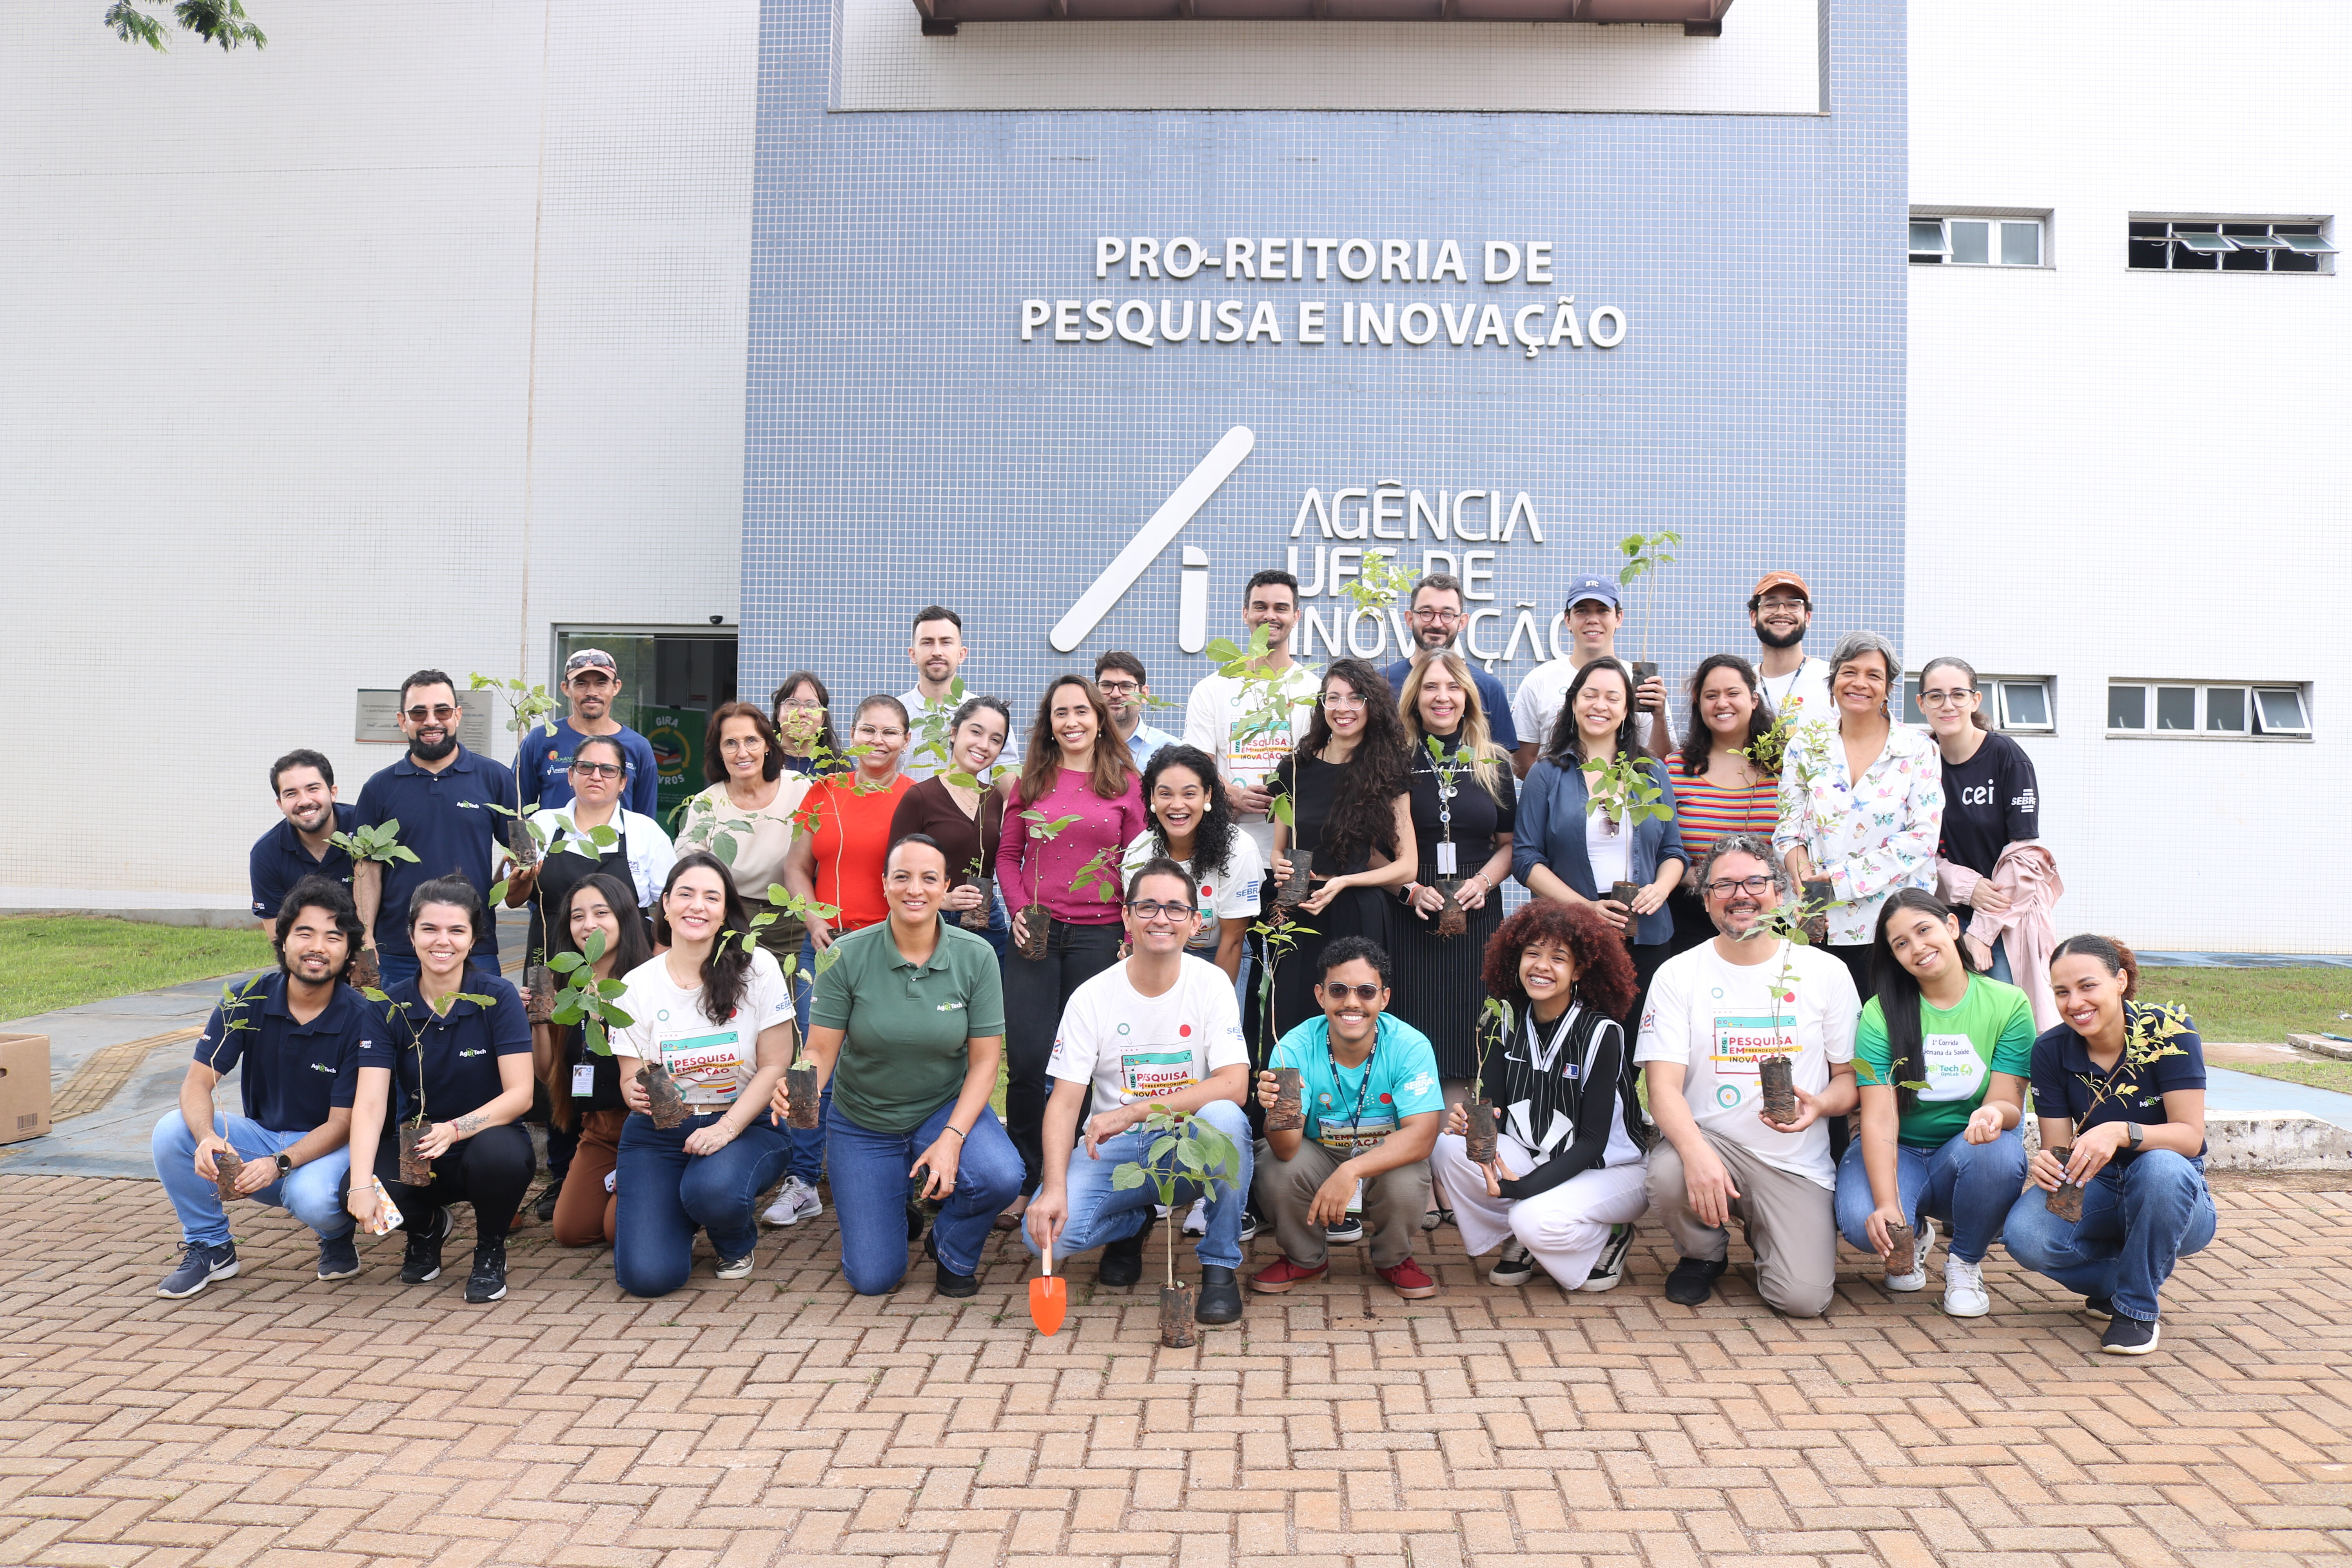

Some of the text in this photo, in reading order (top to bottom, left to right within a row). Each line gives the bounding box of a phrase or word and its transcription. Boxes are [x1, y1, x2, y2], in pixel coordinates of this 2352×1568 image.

[1484, 240, 1553, 283] DE
[1021, 295, 1627, 358] PESQUISA E INOVAÇÃO
[1290, 479, 1544, 543] AGÊNCIA
[656, 716, 679, 728] GIRA
[658, 774, 685, 785] VROS
[1962, 779, 1994, 805] cei
[456, 800, 479, 809] AgBiTech
[1236, 887, 1260, 898] SEBR
[937, 1002, 963, 1011] AgBiTech
[1054, 1036, 1064, 1054] ei
[1729, 1036, 1793, 1047] PESQUISA
[459, 1048, 486, 1058] AgBiTech
[674, 1053, 735, 1067] PESQUISA
[311, 1063, 337, 1074] AgBiTech
[1925, 1065, 1959, 1073] gBiTech
[1137, 1071, 1188, 1082] PESQUISA
[2139, 1093, 2163, 1108] AgBiTec
